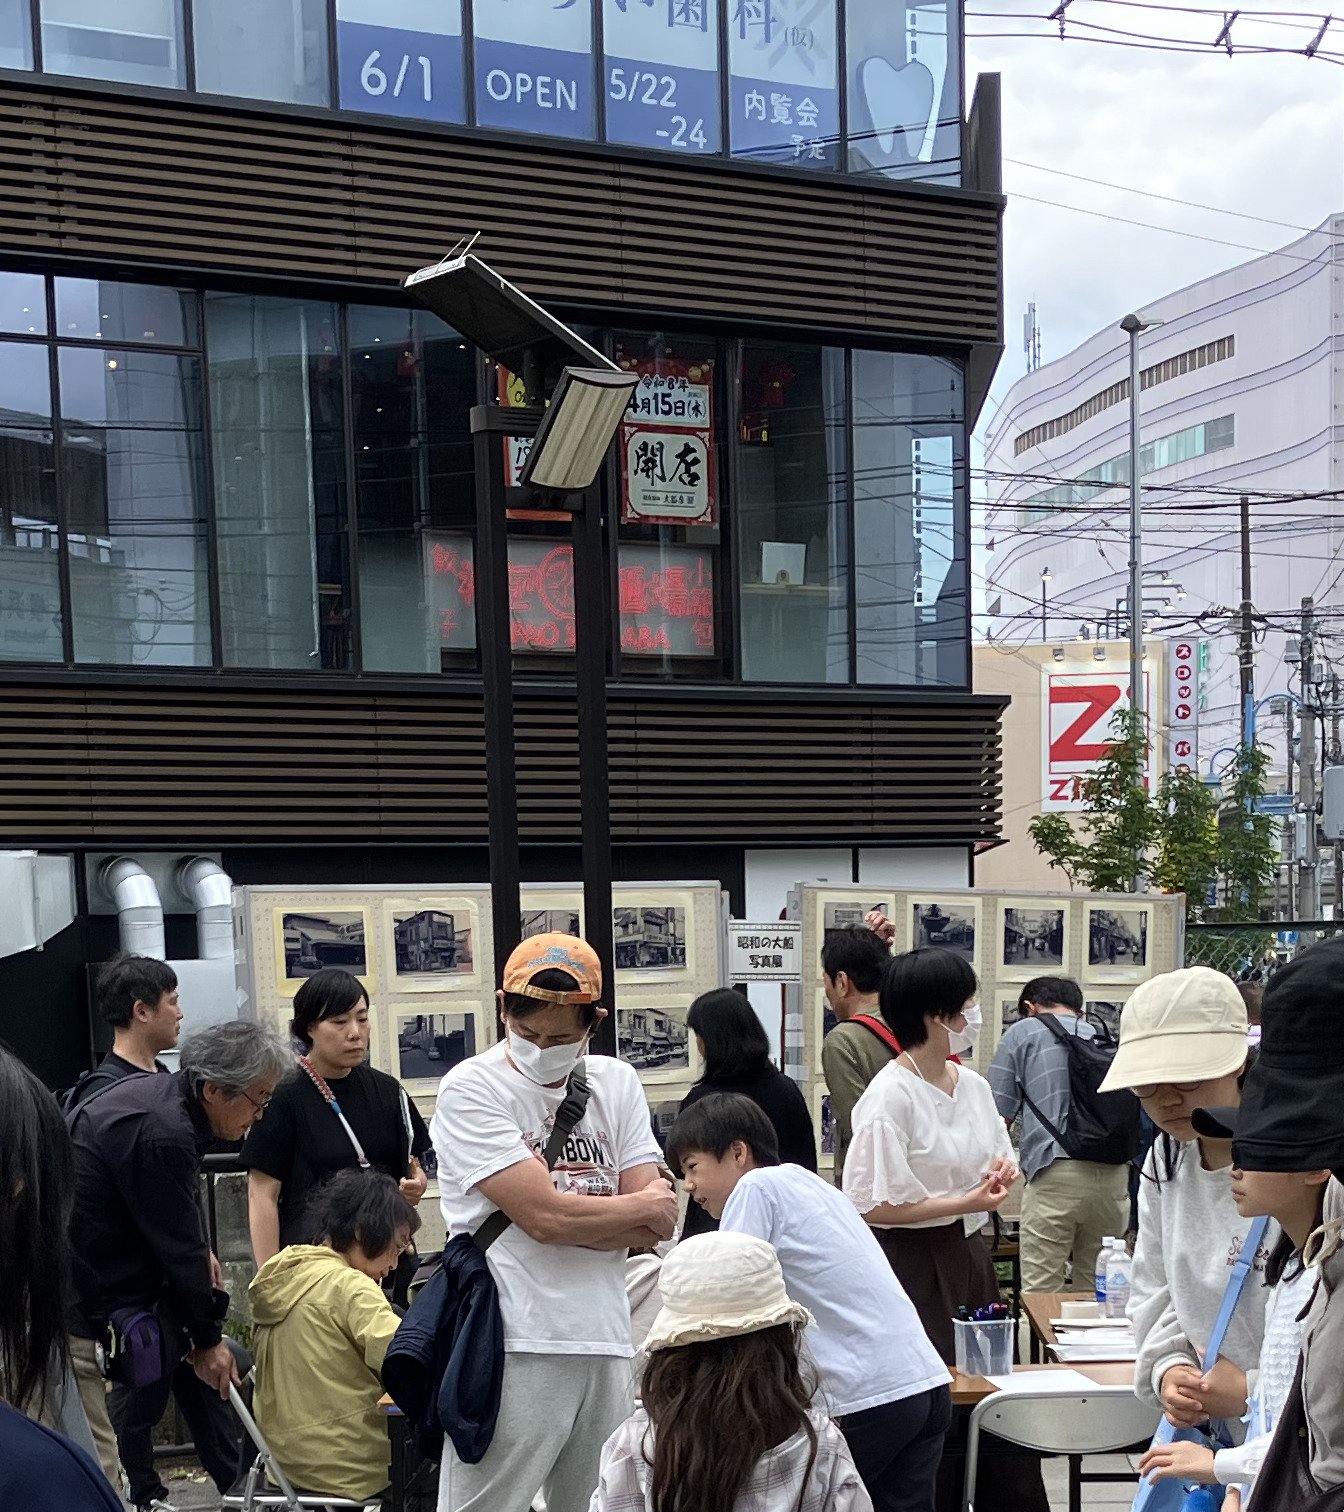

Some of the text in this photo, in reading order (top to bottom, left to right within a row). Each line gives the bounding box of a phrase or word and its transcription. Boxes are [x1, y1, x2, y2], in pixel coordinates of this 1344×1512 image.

[361, 51, 578, 112] 6/1 OPEN
[609, 69, 677, 108] 5/22
[744, 88, 819, 128] 内覧会
[656, 115, 707, 149] -24
[634, 439, 702, 488] 開店
[737, 936, 794, 949] 昭和の大船
[749, 954, 783, 968] 写真展
